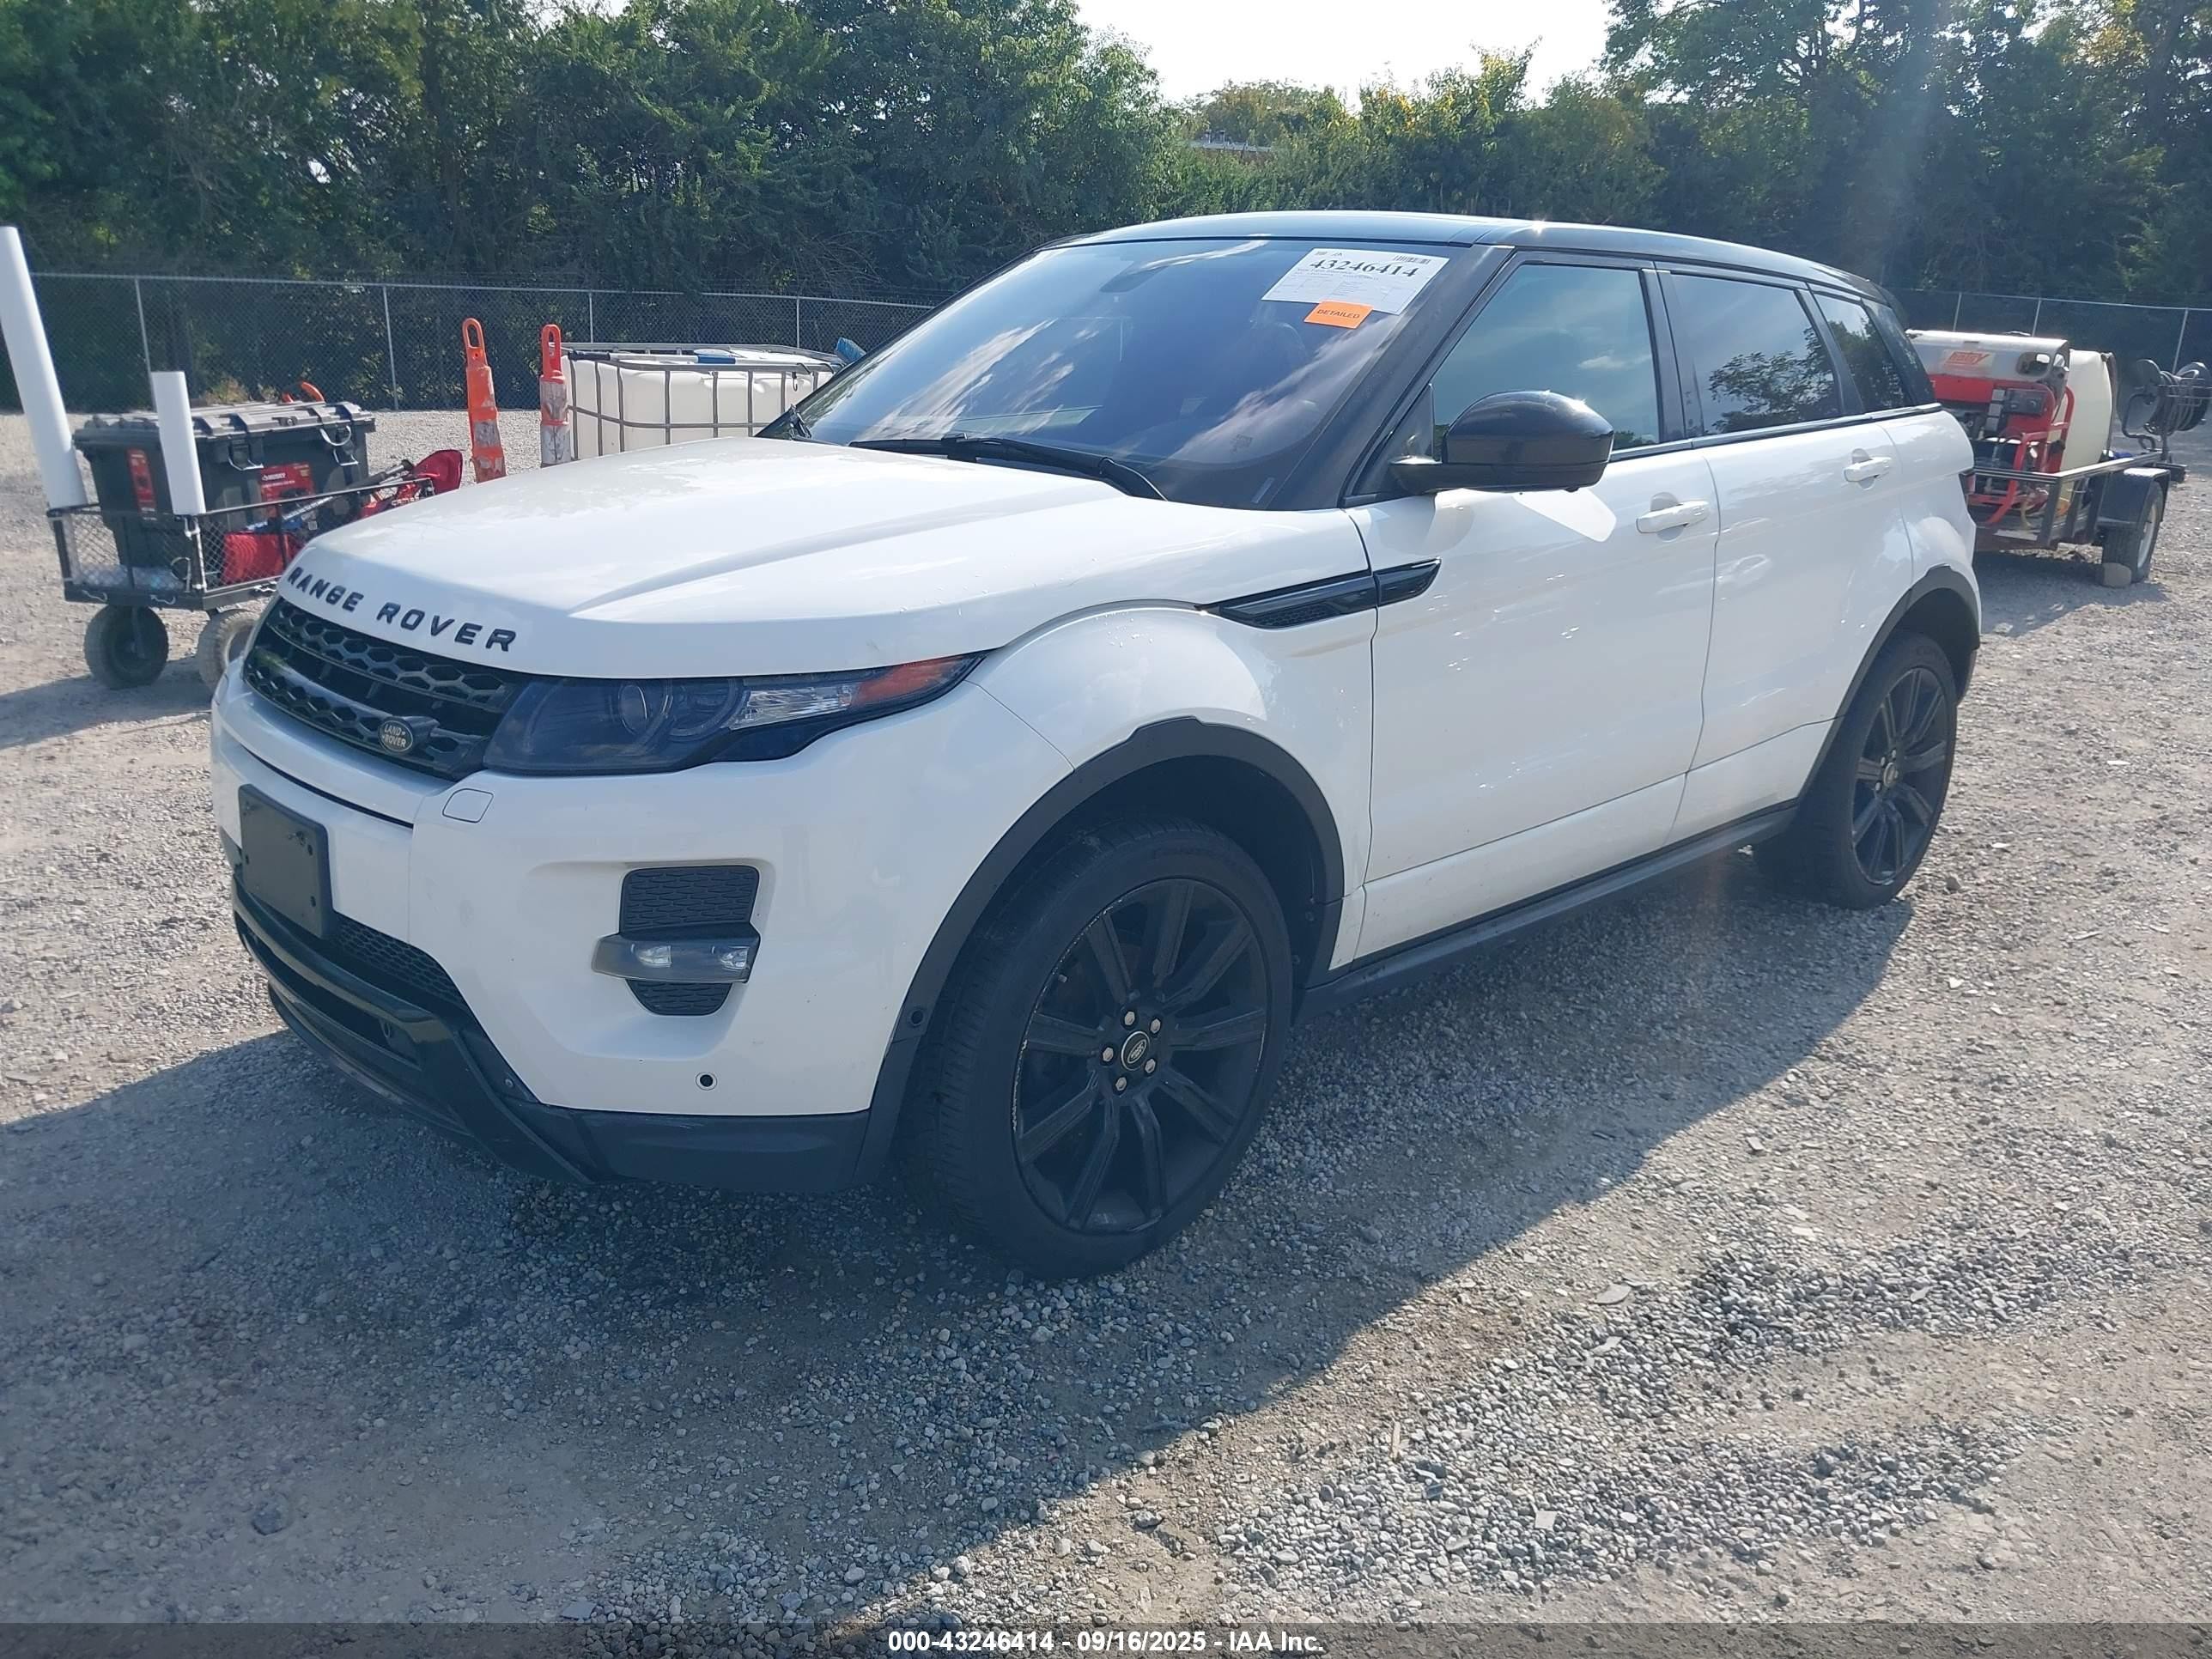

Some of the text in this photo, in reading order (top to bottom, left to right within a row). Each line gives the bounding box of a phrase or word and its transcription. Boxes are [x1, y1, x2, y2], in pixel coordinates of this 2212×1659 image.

[1310, 259, 1419, 277] 43246414
[1316, 308, 1360, 319] DETAILED
[288, 567, 516, 652] RANGE ROVER
[384, 724, 402, 736] LAND
[384, 734, 407, 748] ROVER
